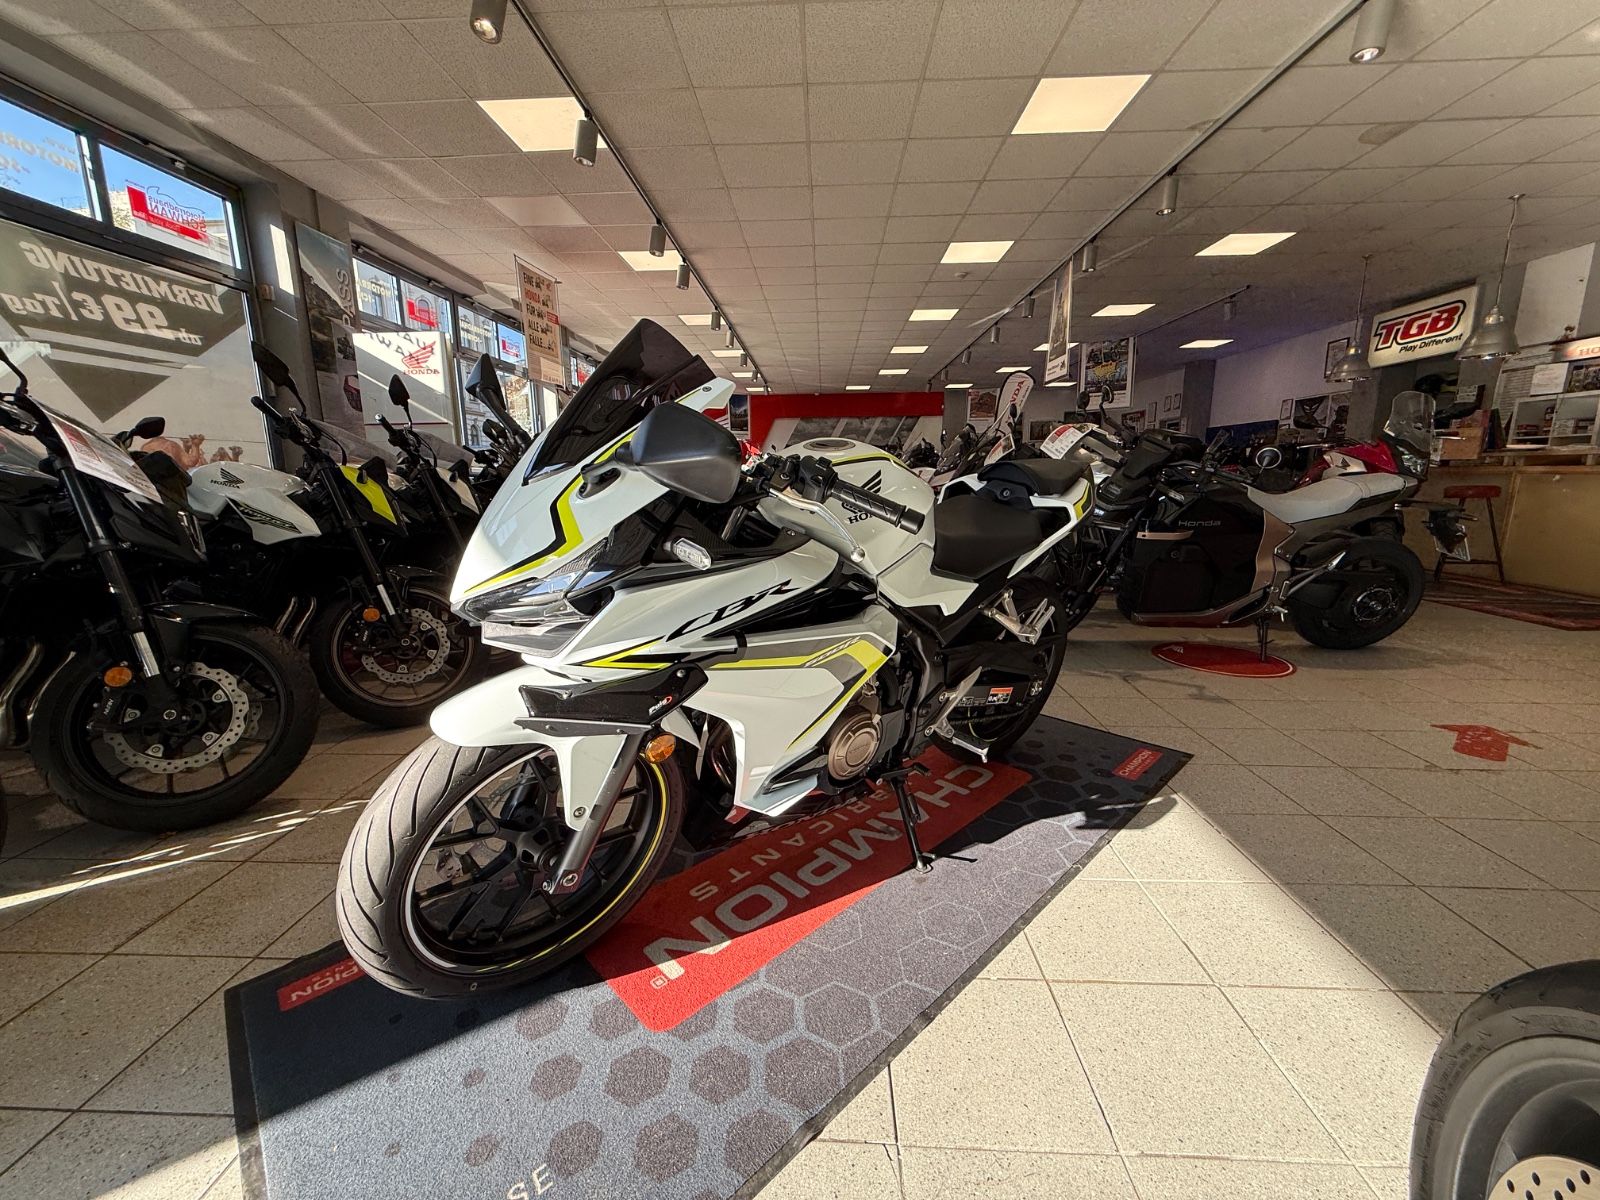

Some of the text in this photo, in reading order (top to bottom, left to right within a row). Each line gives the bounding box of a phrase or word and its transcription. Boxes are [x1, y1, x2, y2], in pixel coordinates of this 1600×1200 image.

[523, 272, 535, 288] EINE
[524, 288, 541, 305] HONDA
[526, 302, 536, 318] FÜR
[528, 319, 539, 333] ALLE
[1376, 301, 1464, 348] TGB
[1399, 333, 1463, 354] Play Different
[210, 479, 241, 489] HONDA
[1178, 519, 1222, 528] Honda
[689, 768, 923, 902] LBRICANTS
[643, 763, 994, 980] CHAMPION
